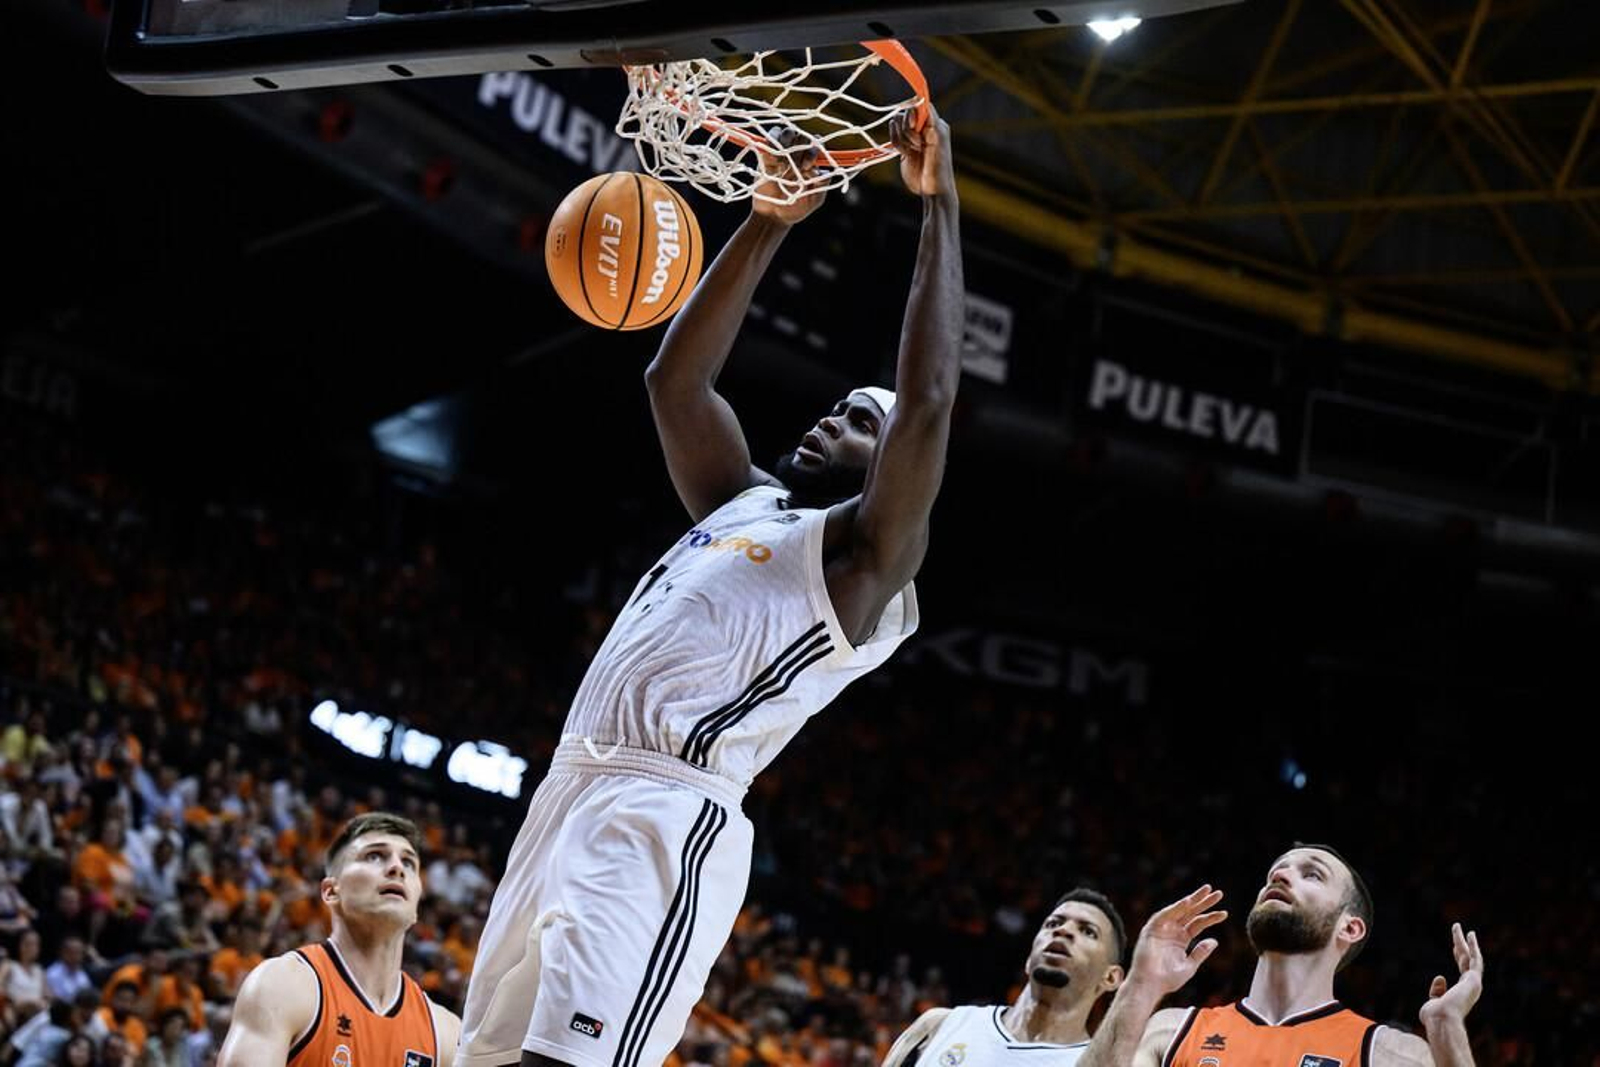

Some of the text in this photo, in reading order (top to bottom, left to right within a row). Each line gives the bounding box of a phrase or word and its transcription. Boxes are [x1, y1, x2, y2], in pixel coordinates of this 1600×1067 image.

[598, 213, 623, 279] EVO
[641, 200, 681, 304] Wilson
[1088, 358, 1281, 456] PULEVA
[900, 626, 1150, 707] KGM
[573, 1020, 596, 1035] acb
